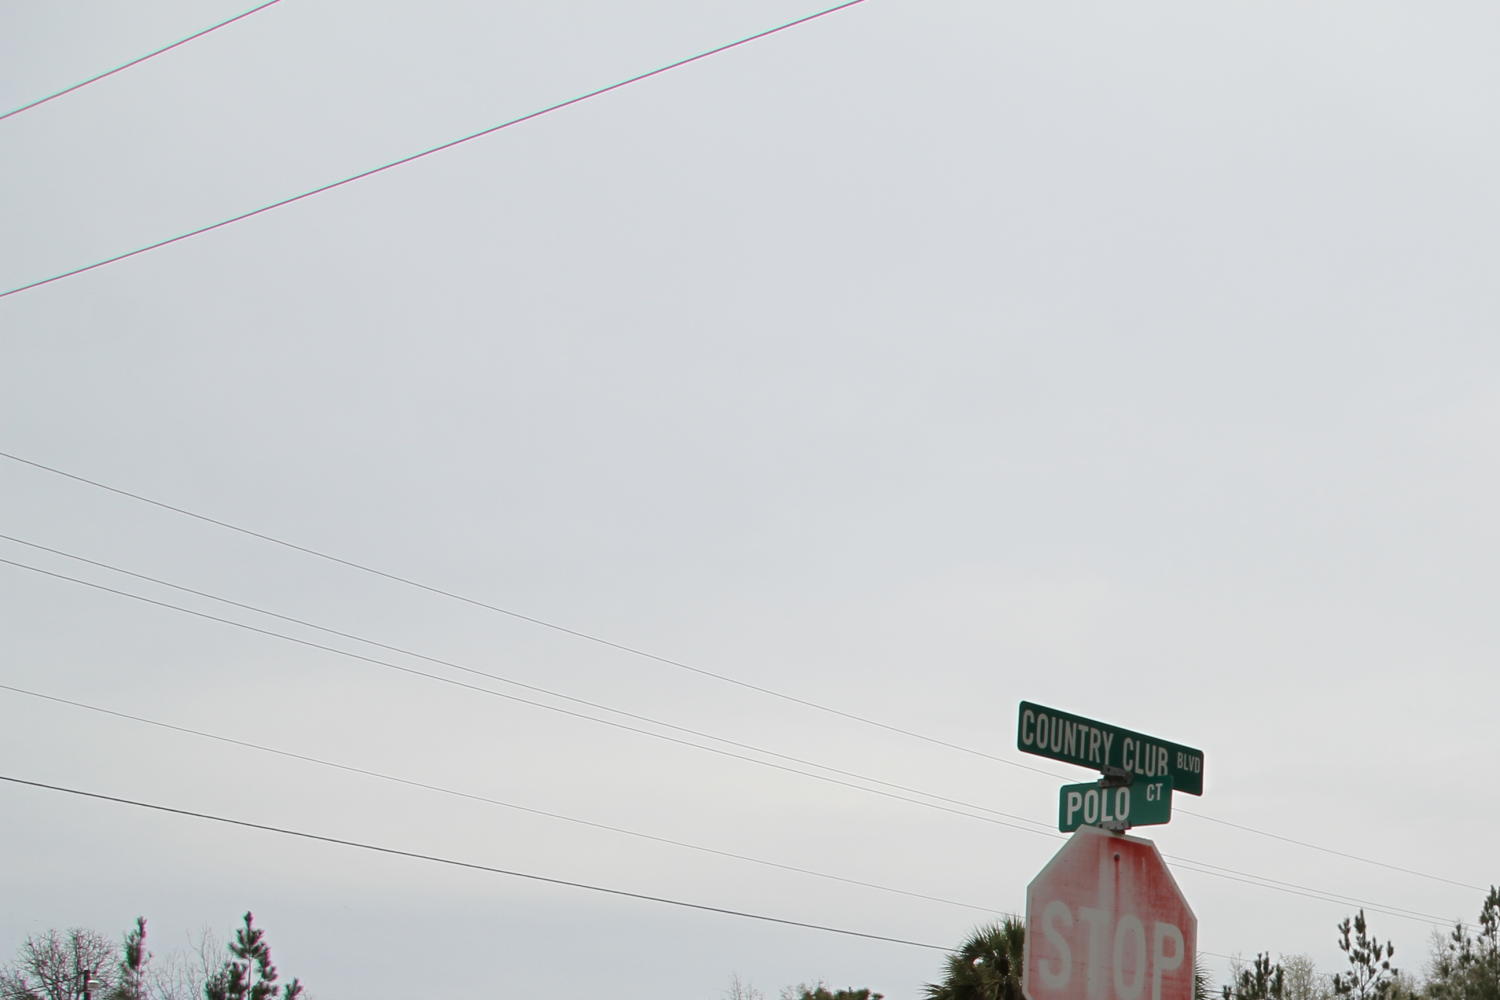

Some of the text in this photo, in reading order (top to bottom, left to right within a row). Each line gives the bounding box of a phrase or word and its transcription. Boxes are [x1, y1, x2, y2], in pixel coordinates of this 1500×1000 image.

[1022, 709, 1114, 766] COUNTRY
[1177, 752, 1201, 774] BLVD
[1066, 783, 1164, 826] POLO CT
